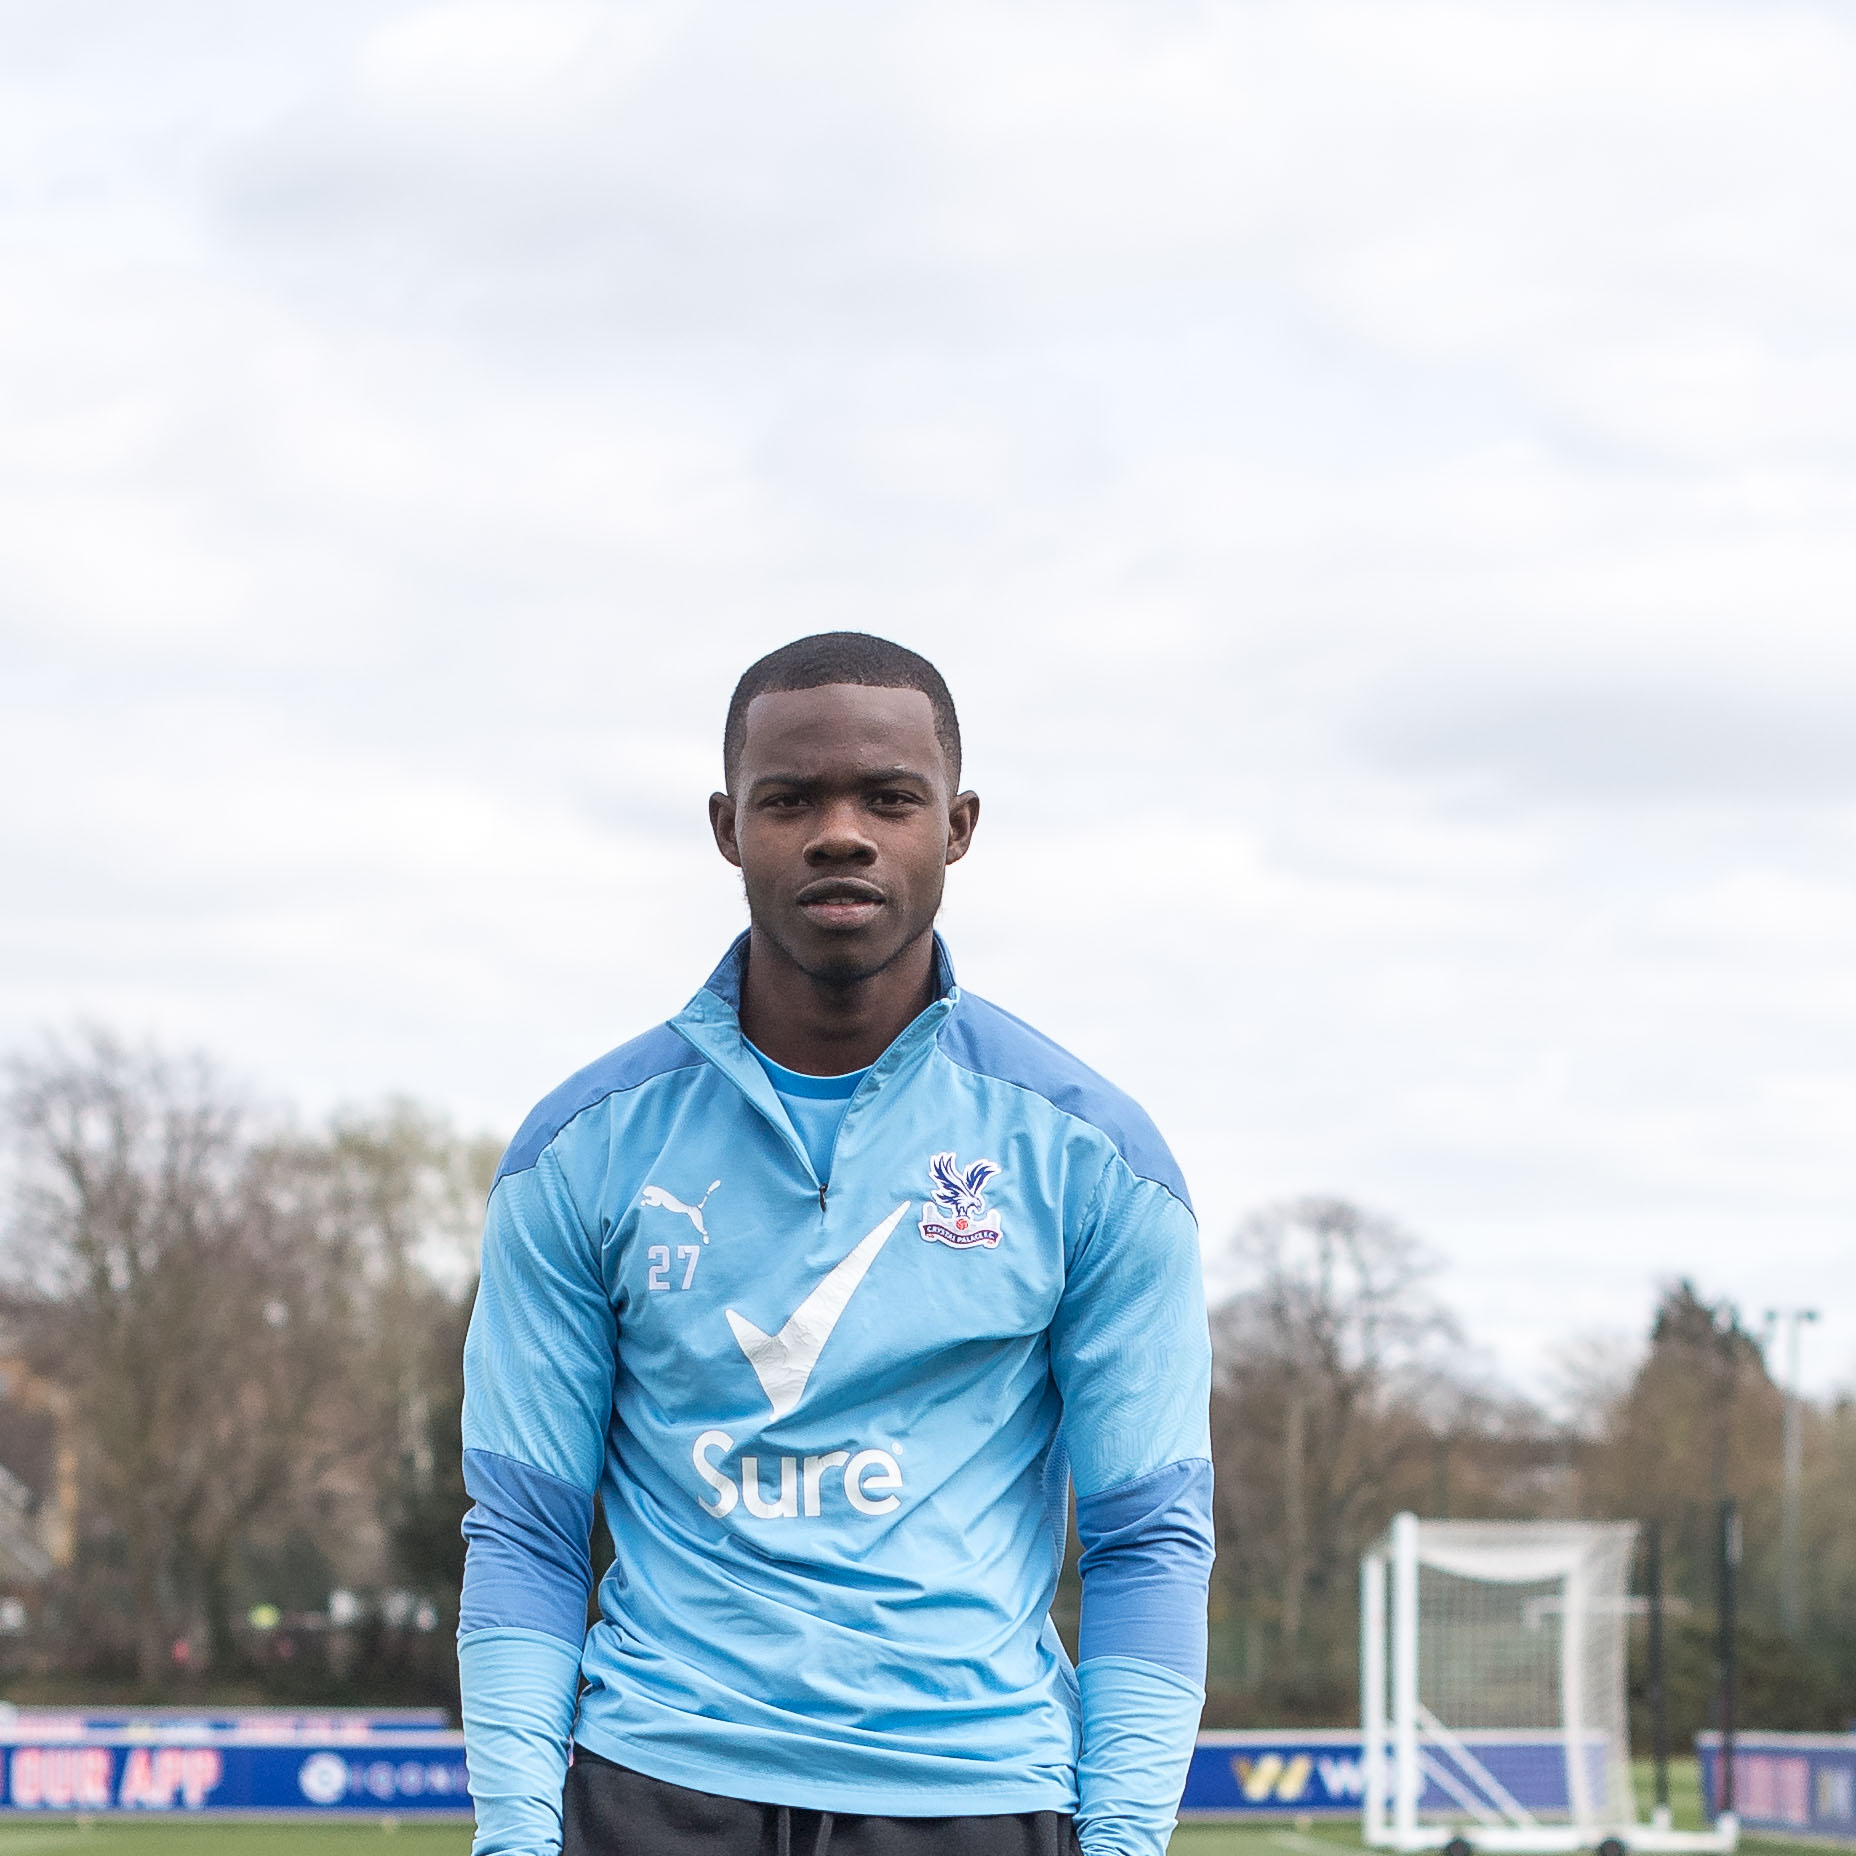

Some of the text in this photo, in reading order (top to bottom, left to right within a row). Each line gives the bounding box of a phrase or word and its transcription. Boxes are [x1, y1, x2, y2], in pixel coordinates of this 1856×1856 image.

[927, 1225, 956, 1242] CRYSTAL
[957, 1233, 983, 1243] PALACE
[647, 1245, 701, 1291] 27
[692, 1430, 904, 1519] Sure
[118, 1746, 223, 1810] APP
